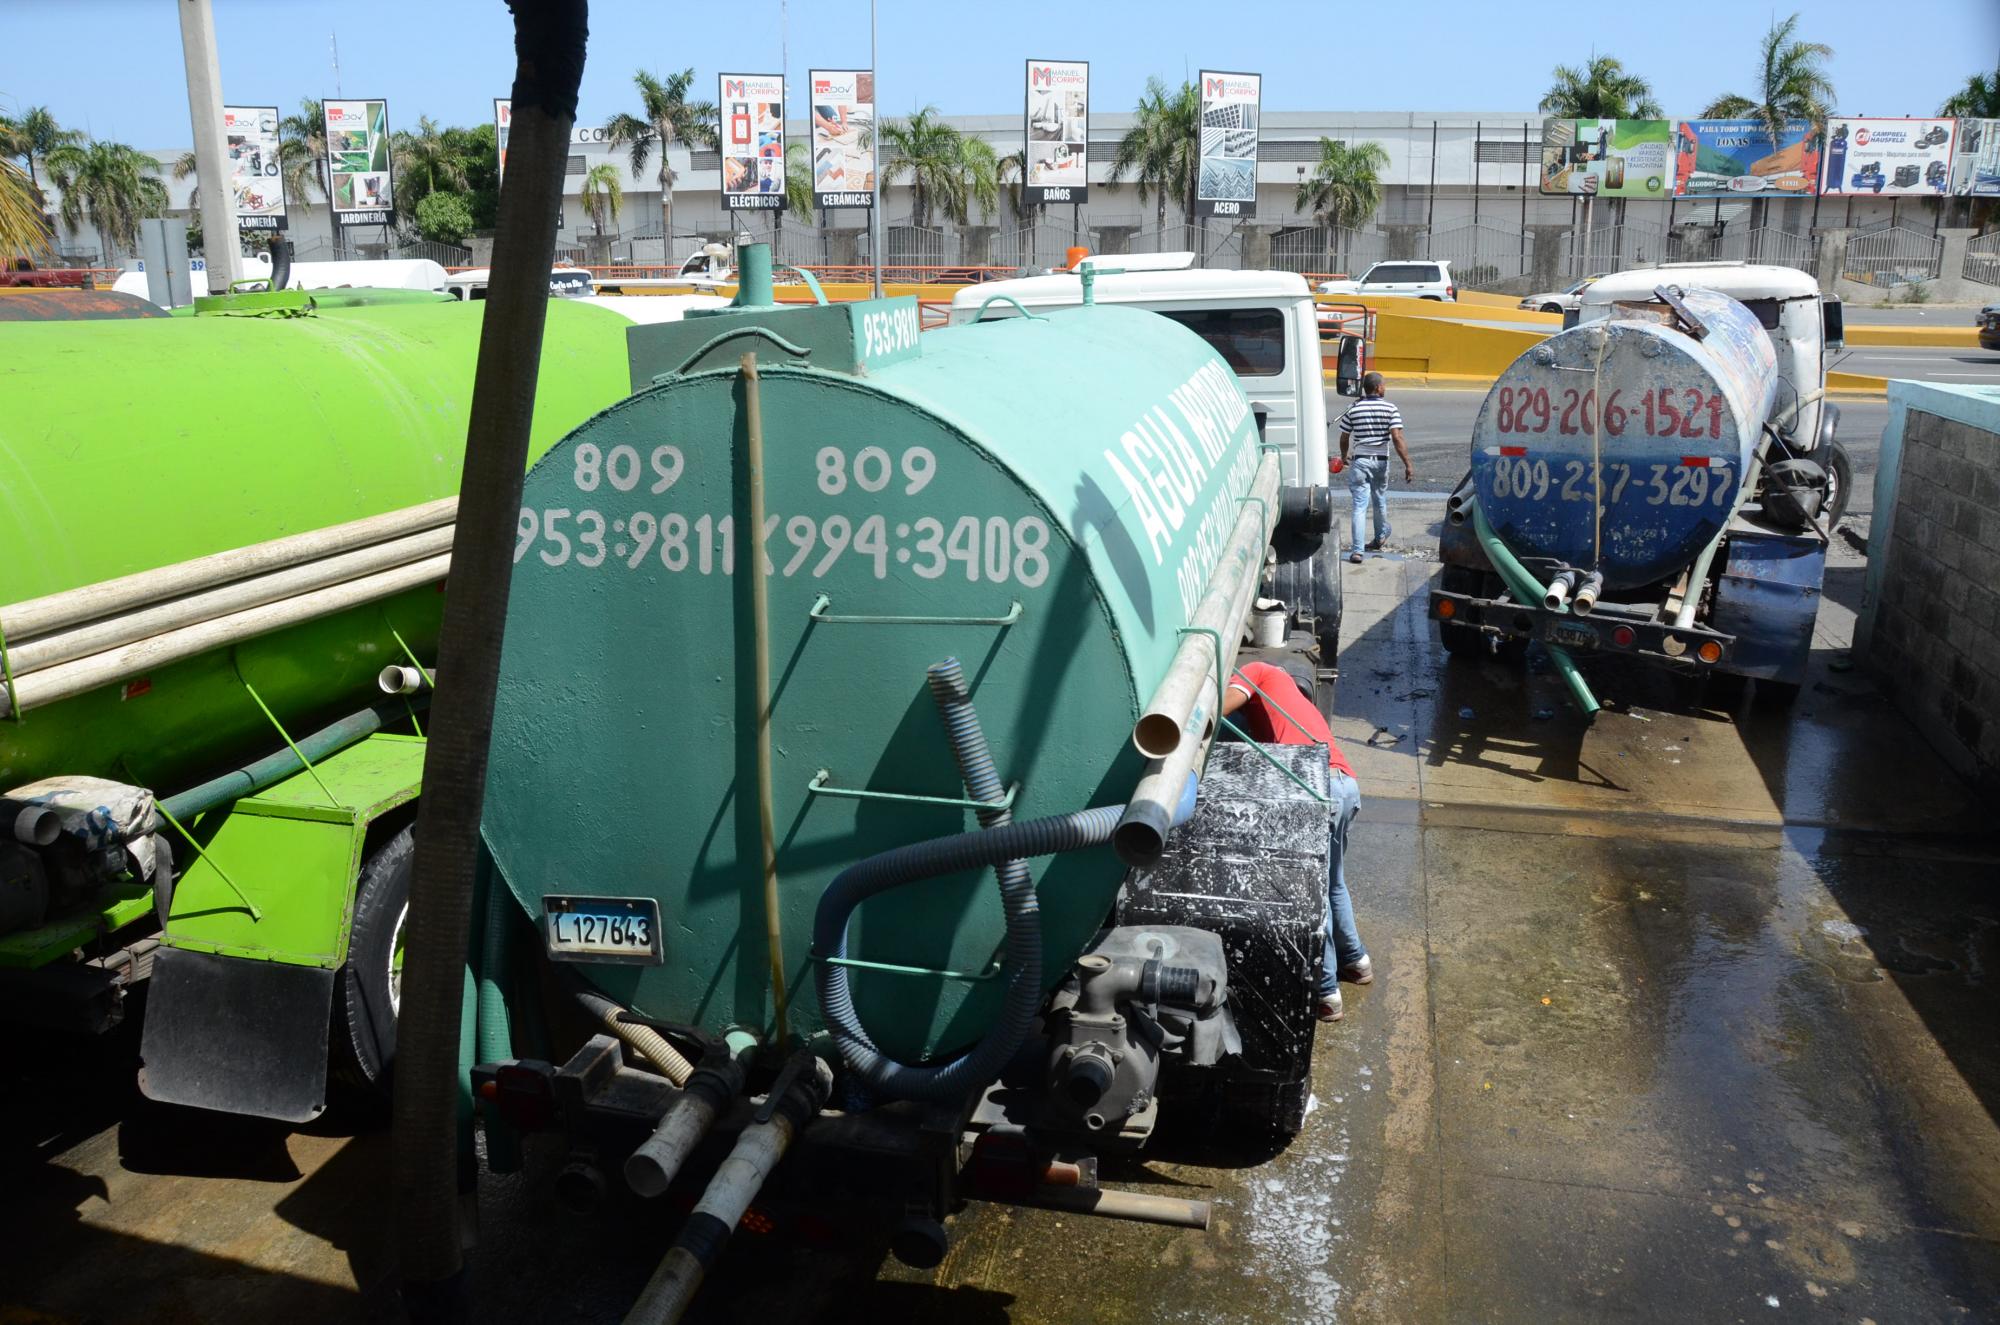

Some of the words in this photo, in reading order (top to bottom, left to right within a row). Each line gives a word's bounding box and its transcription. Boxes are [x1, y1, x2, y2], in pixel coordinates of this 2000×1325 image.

[1052, 69, 1079, 77] MANUEL
[1052, 76, 1085, 84] CORRIPIO
[745, 88, 780, 96] CORRIPIO
[1225, 88, 1257, 96] CORRIPIO
[1715, 137, 1750, 148] LONAS
[822, 191, 872, 206] CERÁMICAS
[1043, 186, 1071, 201] BAÑOS
[729, 194, 780, 208] ELÉCTRICOS
[1213, 201, 1240, 214] ACERO
[237, 216, 278, 228] PLOMERÍA
[340, 212, 388, 224] JARDINERÍA
[863, 305, 918, 358] 953:9811
[1104, 404, 1209, 567] AGUA
[1167, 357, 1249, 470] NATURAL
[573, 442, 684, 496] 809
[815, 445, 937, 496] 809
